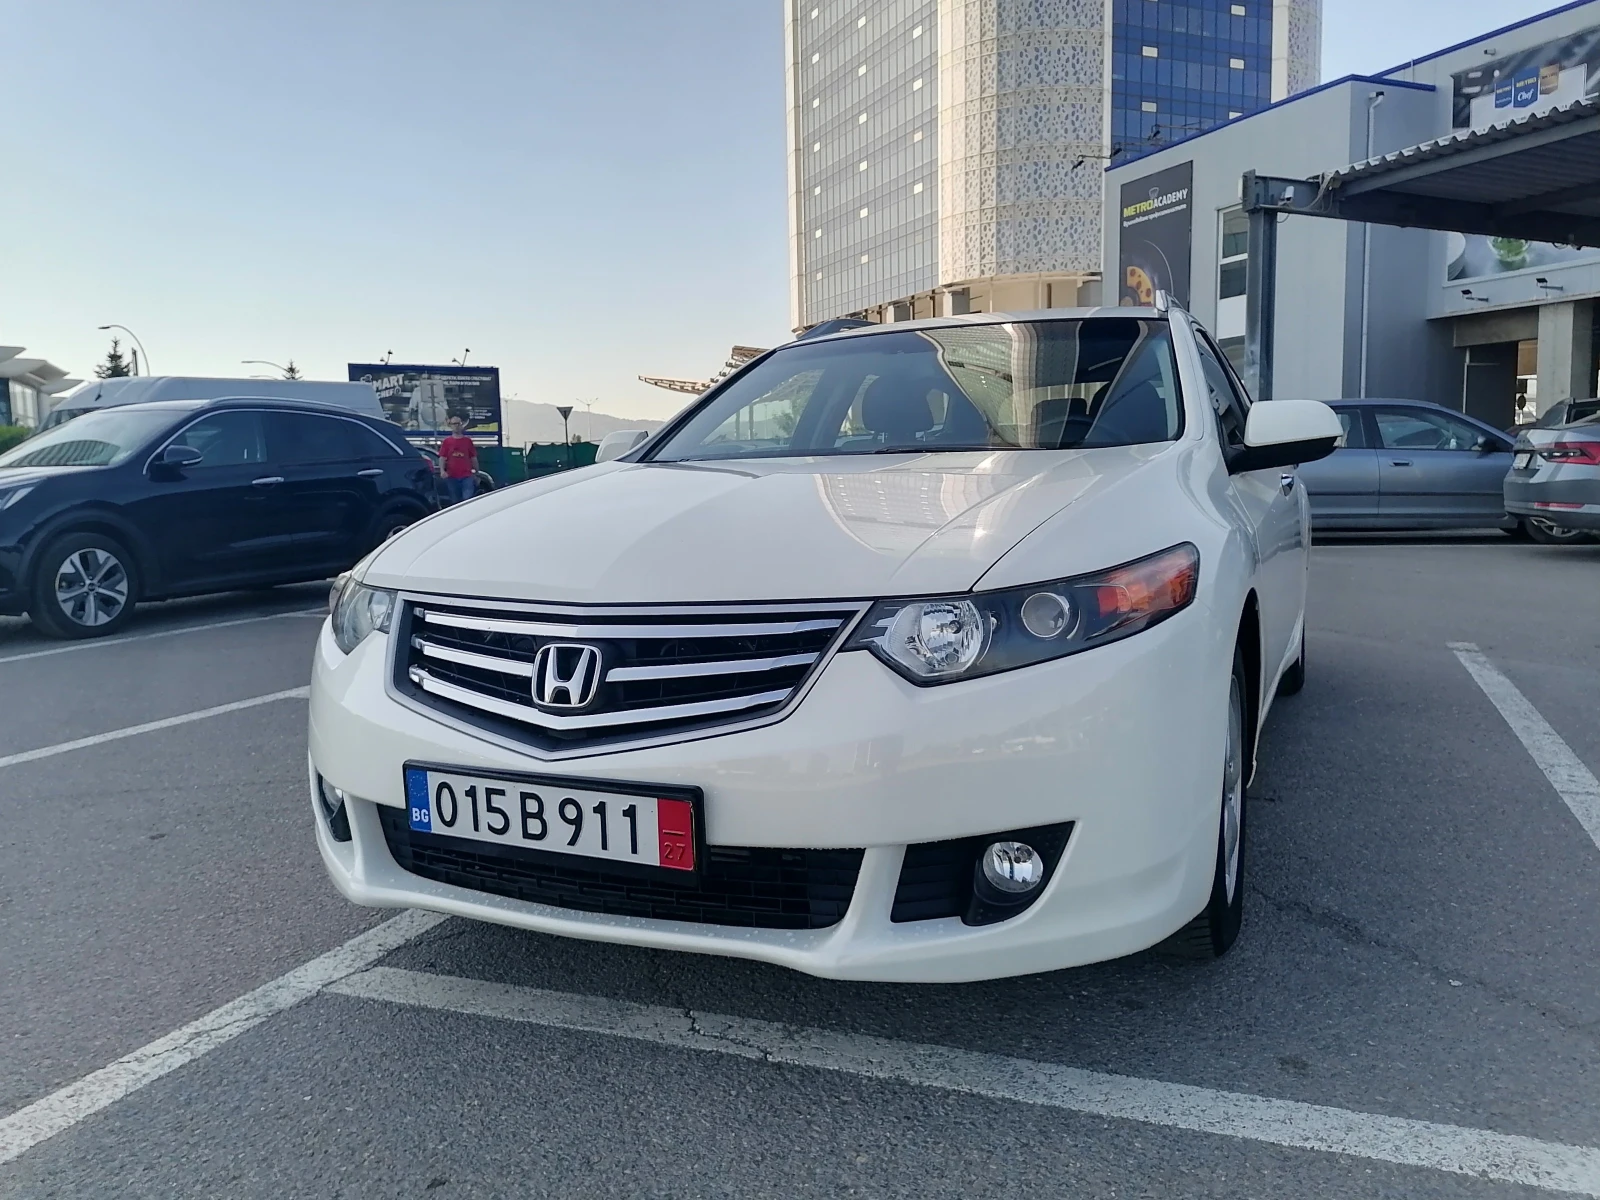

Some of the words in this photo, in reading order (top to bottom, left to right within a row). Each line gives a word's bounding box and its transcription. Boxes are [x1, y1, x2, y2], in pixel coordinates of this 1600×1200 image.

[1516, 77, 1537, 88] METRO
[1517, 89, 1535, 102] Chef
[371, 373, 405, 392] MART
[412, 807, 430, 823] BG
[664, 842, 686, 861] 27
